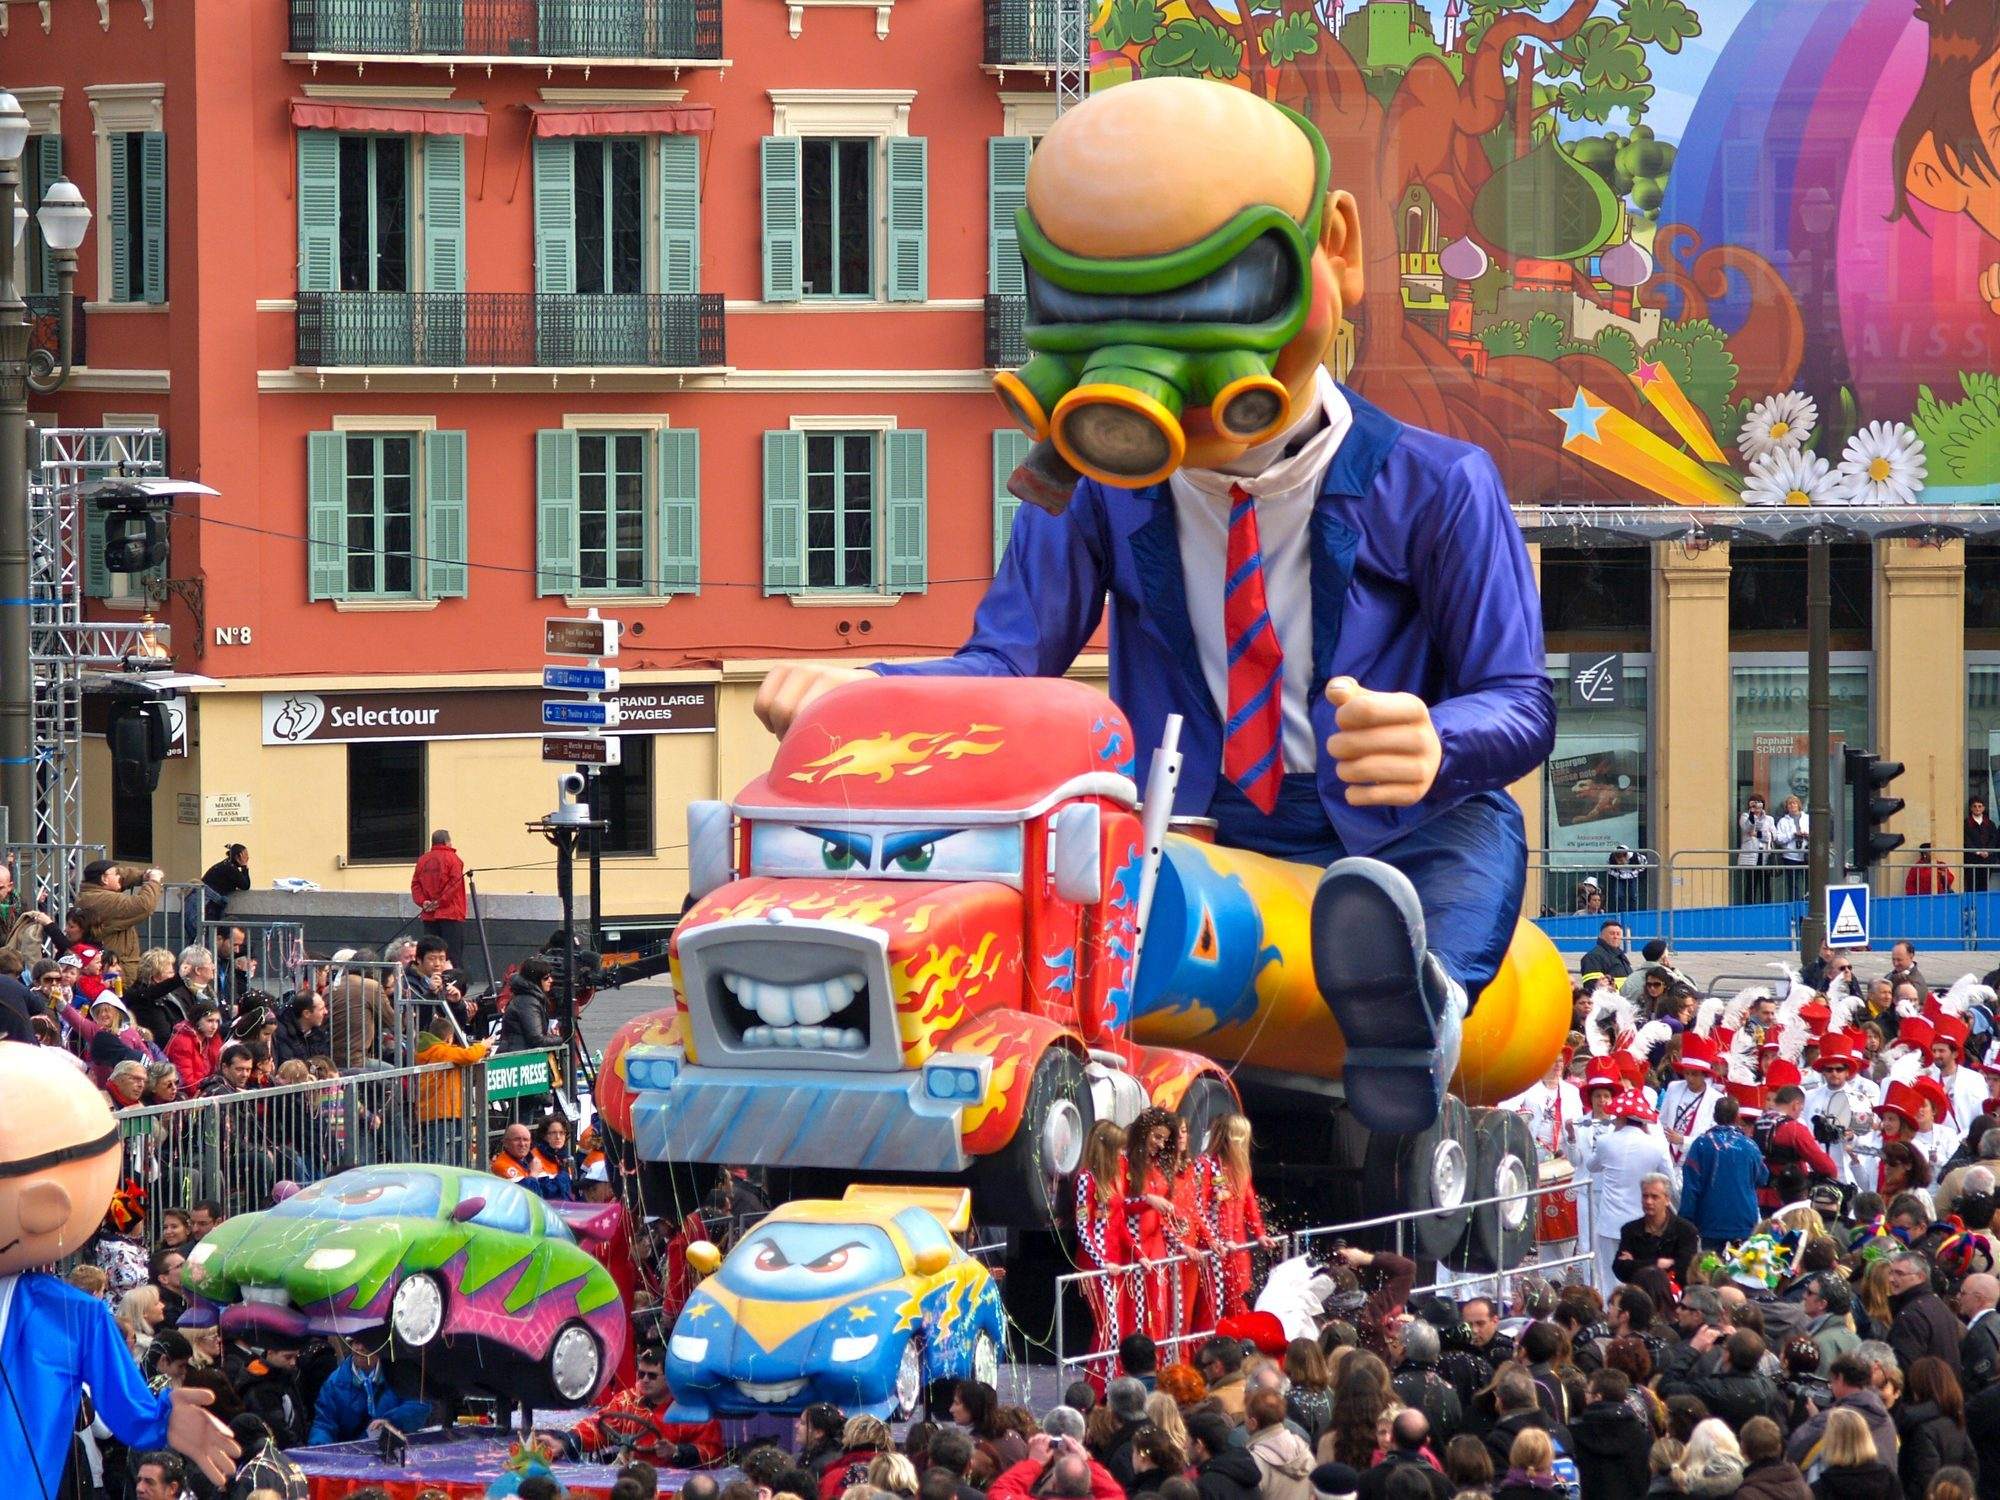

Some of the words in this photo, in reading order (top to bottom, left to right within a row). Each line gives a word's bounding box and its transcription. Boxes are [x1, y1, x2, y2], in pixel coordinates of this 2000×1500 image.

[584, 675, 590, 684] de
[660, 695, 705, 706] LARGE
[330, 706, 440, 727] Selectour
[619, 709, 672, 720] OYAGES
[1756, 737, 1794, 747] Raphaël
[1756, 746, 1794, 754] SCHOTT
[487, 1066, 518, 1091] ESERVE
[520, 1062, 548, 1086] PRESSE
